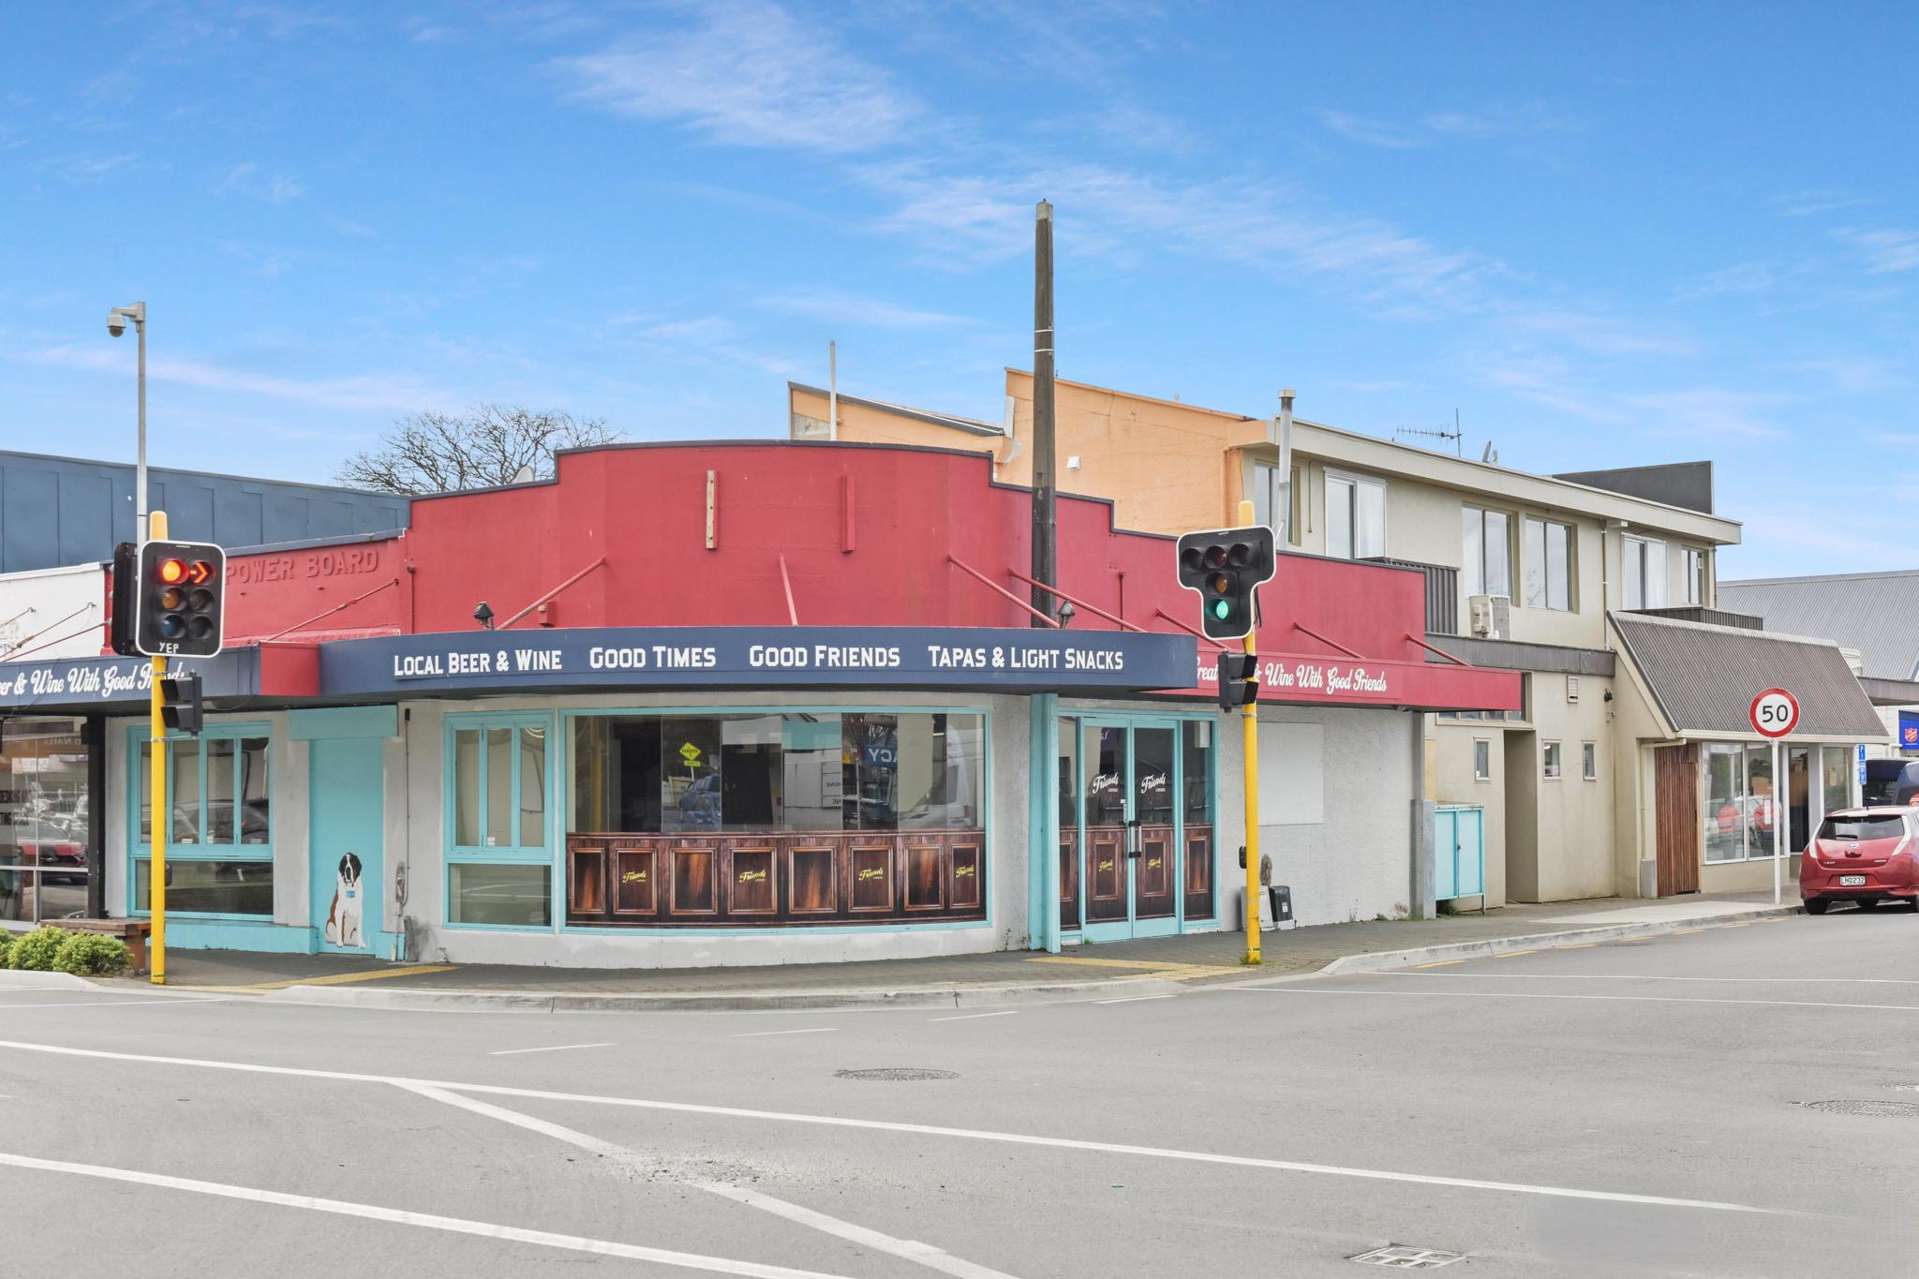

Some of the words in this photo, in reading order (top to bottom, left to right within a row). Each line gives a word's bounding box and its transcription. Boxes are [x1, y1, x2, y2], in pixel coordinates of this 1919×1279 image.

[225, 557, 295, 587] POWER
[307, 550, 380, 578] BOARD
[394, 655, 443, 676] LOCAL
[448, 652, 490, 674] BEER
[496, 650, 509, 671] &
[515, 649, 562, 670] WINE
[590, 647, 646, 668] GOOD
[653, 645, 717, 668] TIMES
[749, 645, 808, 667] GOOD
[815, 645, 900, 667] FRIENDS
[928, 645, 986, 668] TAPAS
[991, 646, 1006, 668] &
[1010, 646, 1060, 669] LIGHT
[1064, 647, 1123, 670] SNACKS
[14, 672, 28, 695] &
[31, 669, 65, 694] Wine
[67, 666, 100, 692] With
[102, 665, 137, 697] Good
[1197, 656, 1218, 681] reat
[1265, 662, 1295, 687] Wine
[1296, 664, 1323, 688] With
[1326, 667, 1352, 694] Good
[1352, 668, 1387, 692] Friends
[1762, 704, 1788, 723] 50
[1092, 771, 1119, 794] Friends
[1141, 771, 1166, 794] Friends
